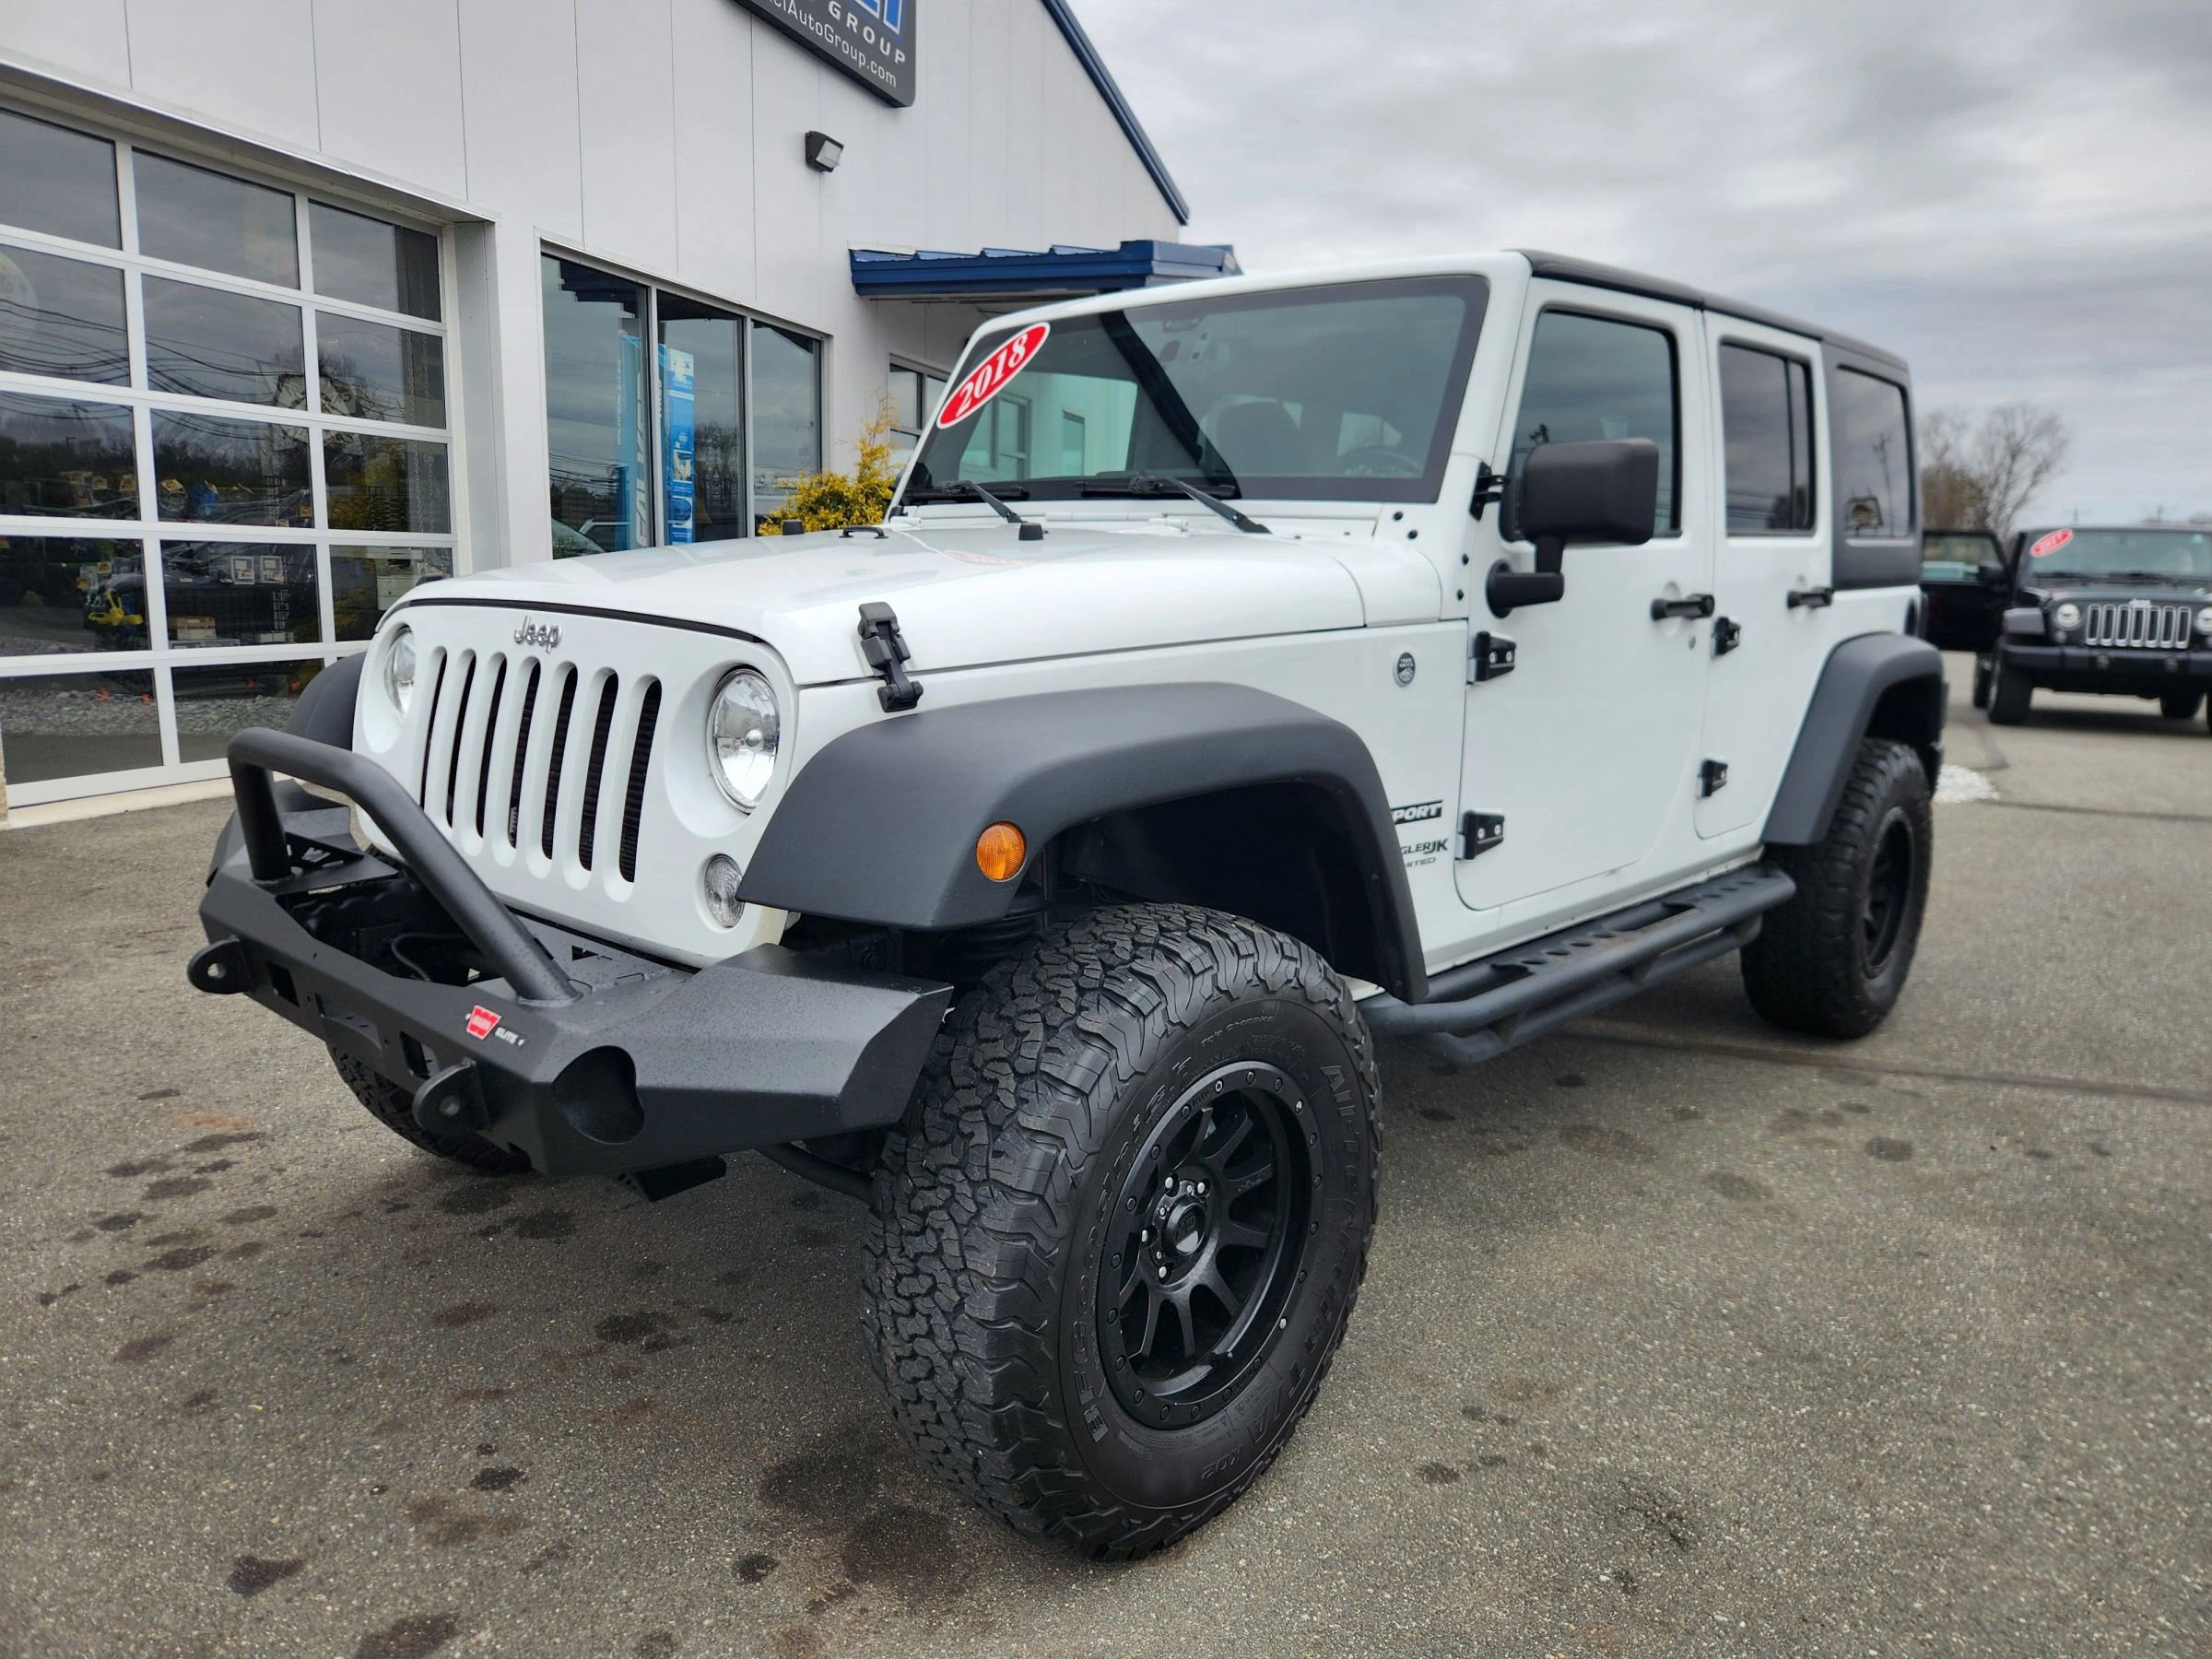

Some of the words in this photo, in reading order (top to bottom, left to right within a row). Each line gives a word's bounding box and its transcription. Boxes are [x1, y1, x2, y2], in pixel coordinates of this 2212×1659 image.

[829, 1, 906, 64] GROUP
[956, 333, 1028, 418] 2018
[514, 616, 563, 653] Jeep
[1392, 803, 1441, 823] PORT
